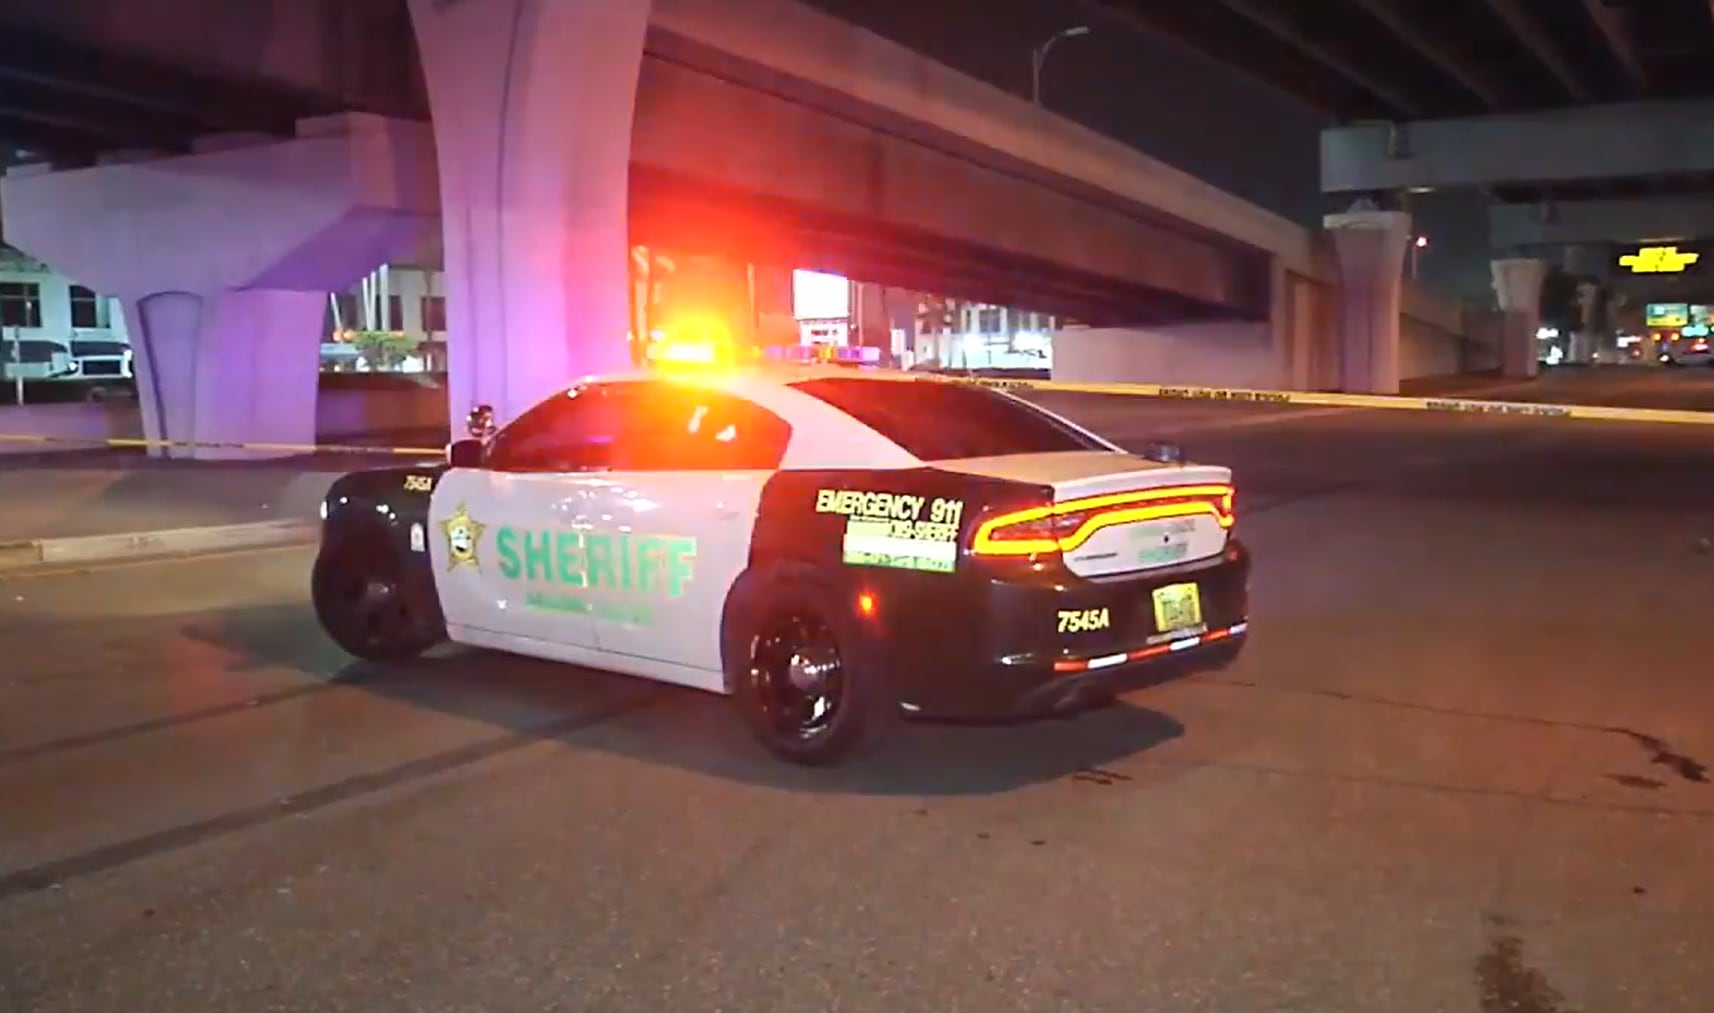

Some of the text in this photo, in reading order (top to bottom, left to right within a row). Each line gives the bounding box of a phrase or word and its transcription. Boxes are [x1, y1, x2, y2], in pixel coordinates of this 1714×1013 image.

[816, 489, 963, 524] EMERGENCY 911
[496, 525, 697, 598] SHERIFF
[1057, 607, 1110, 632] 7545A
